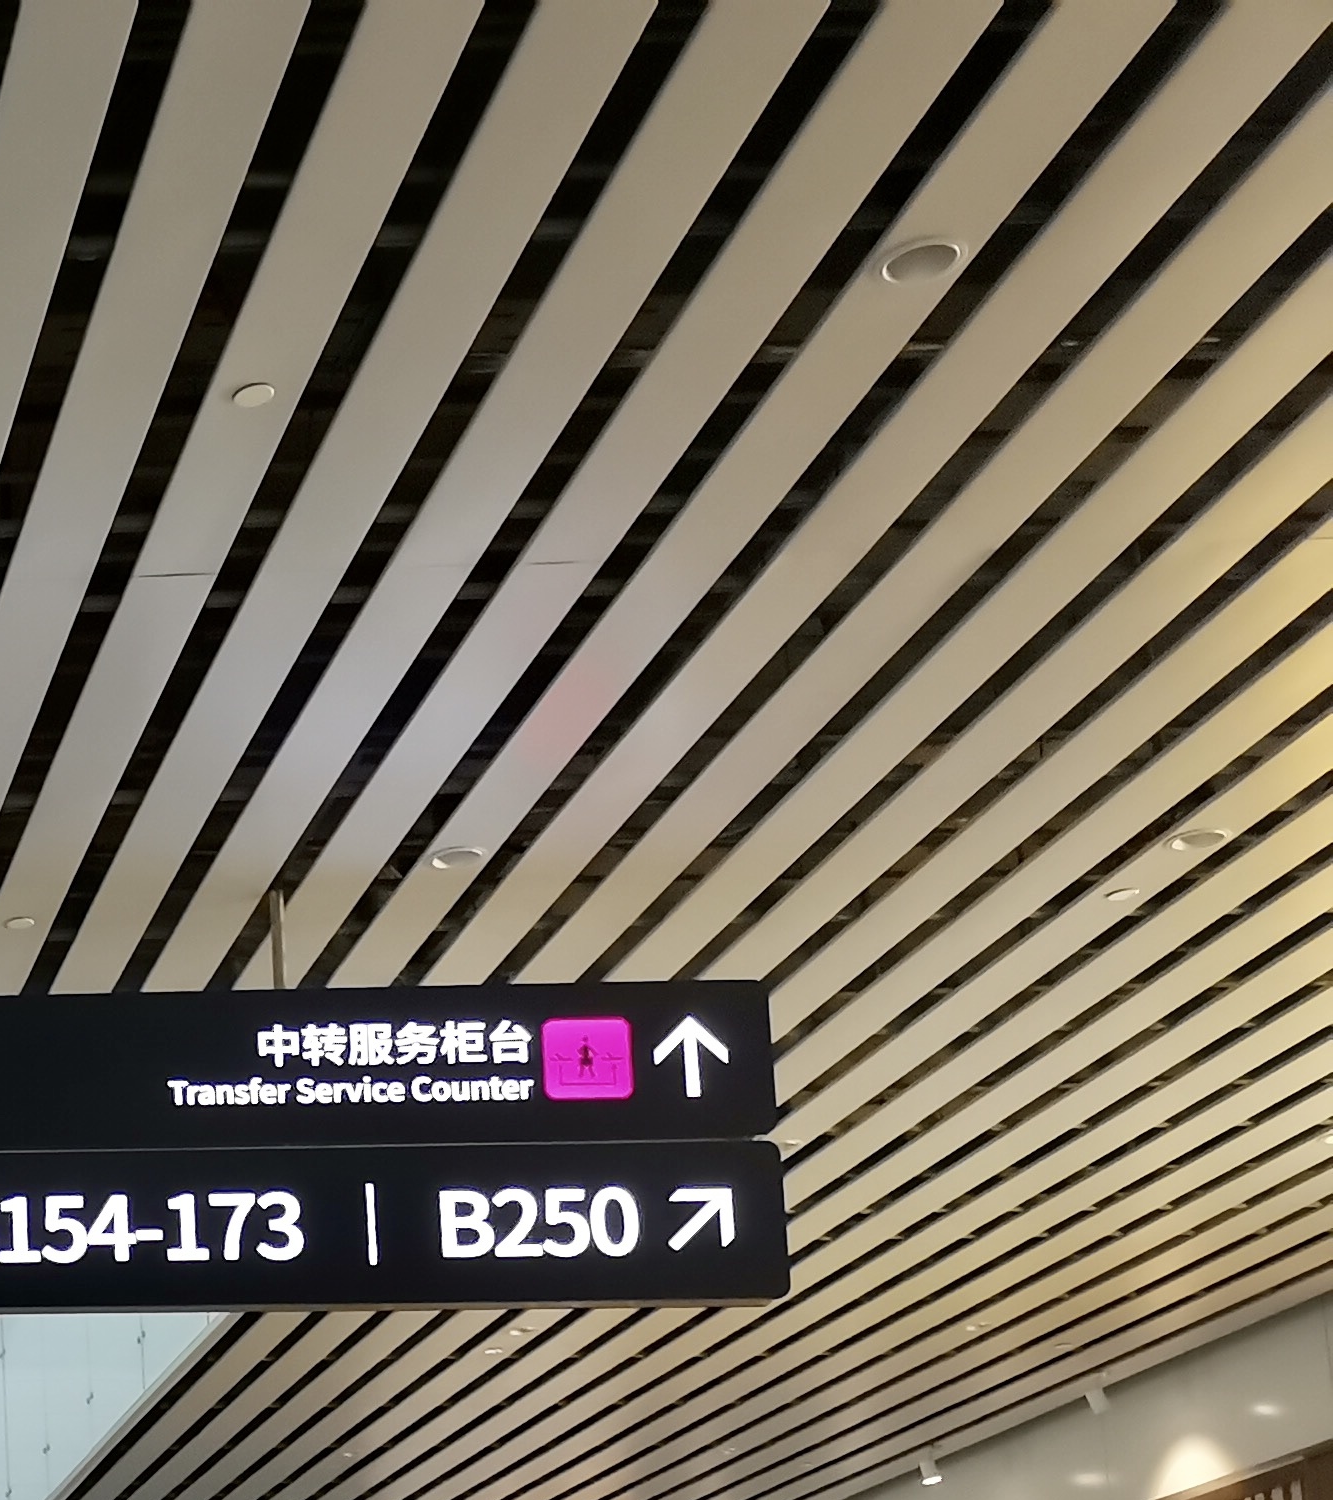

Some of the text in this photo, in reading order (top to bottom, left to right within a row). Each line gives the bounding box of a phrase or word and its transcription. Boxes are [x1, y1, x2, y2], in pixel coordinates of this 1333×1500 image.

[256, 1019, 533, 1067] 中转服务柜台
[167, 1075, 535, 1106] Transfer Service Counter
[438, 1186, 641, 1258] B250
